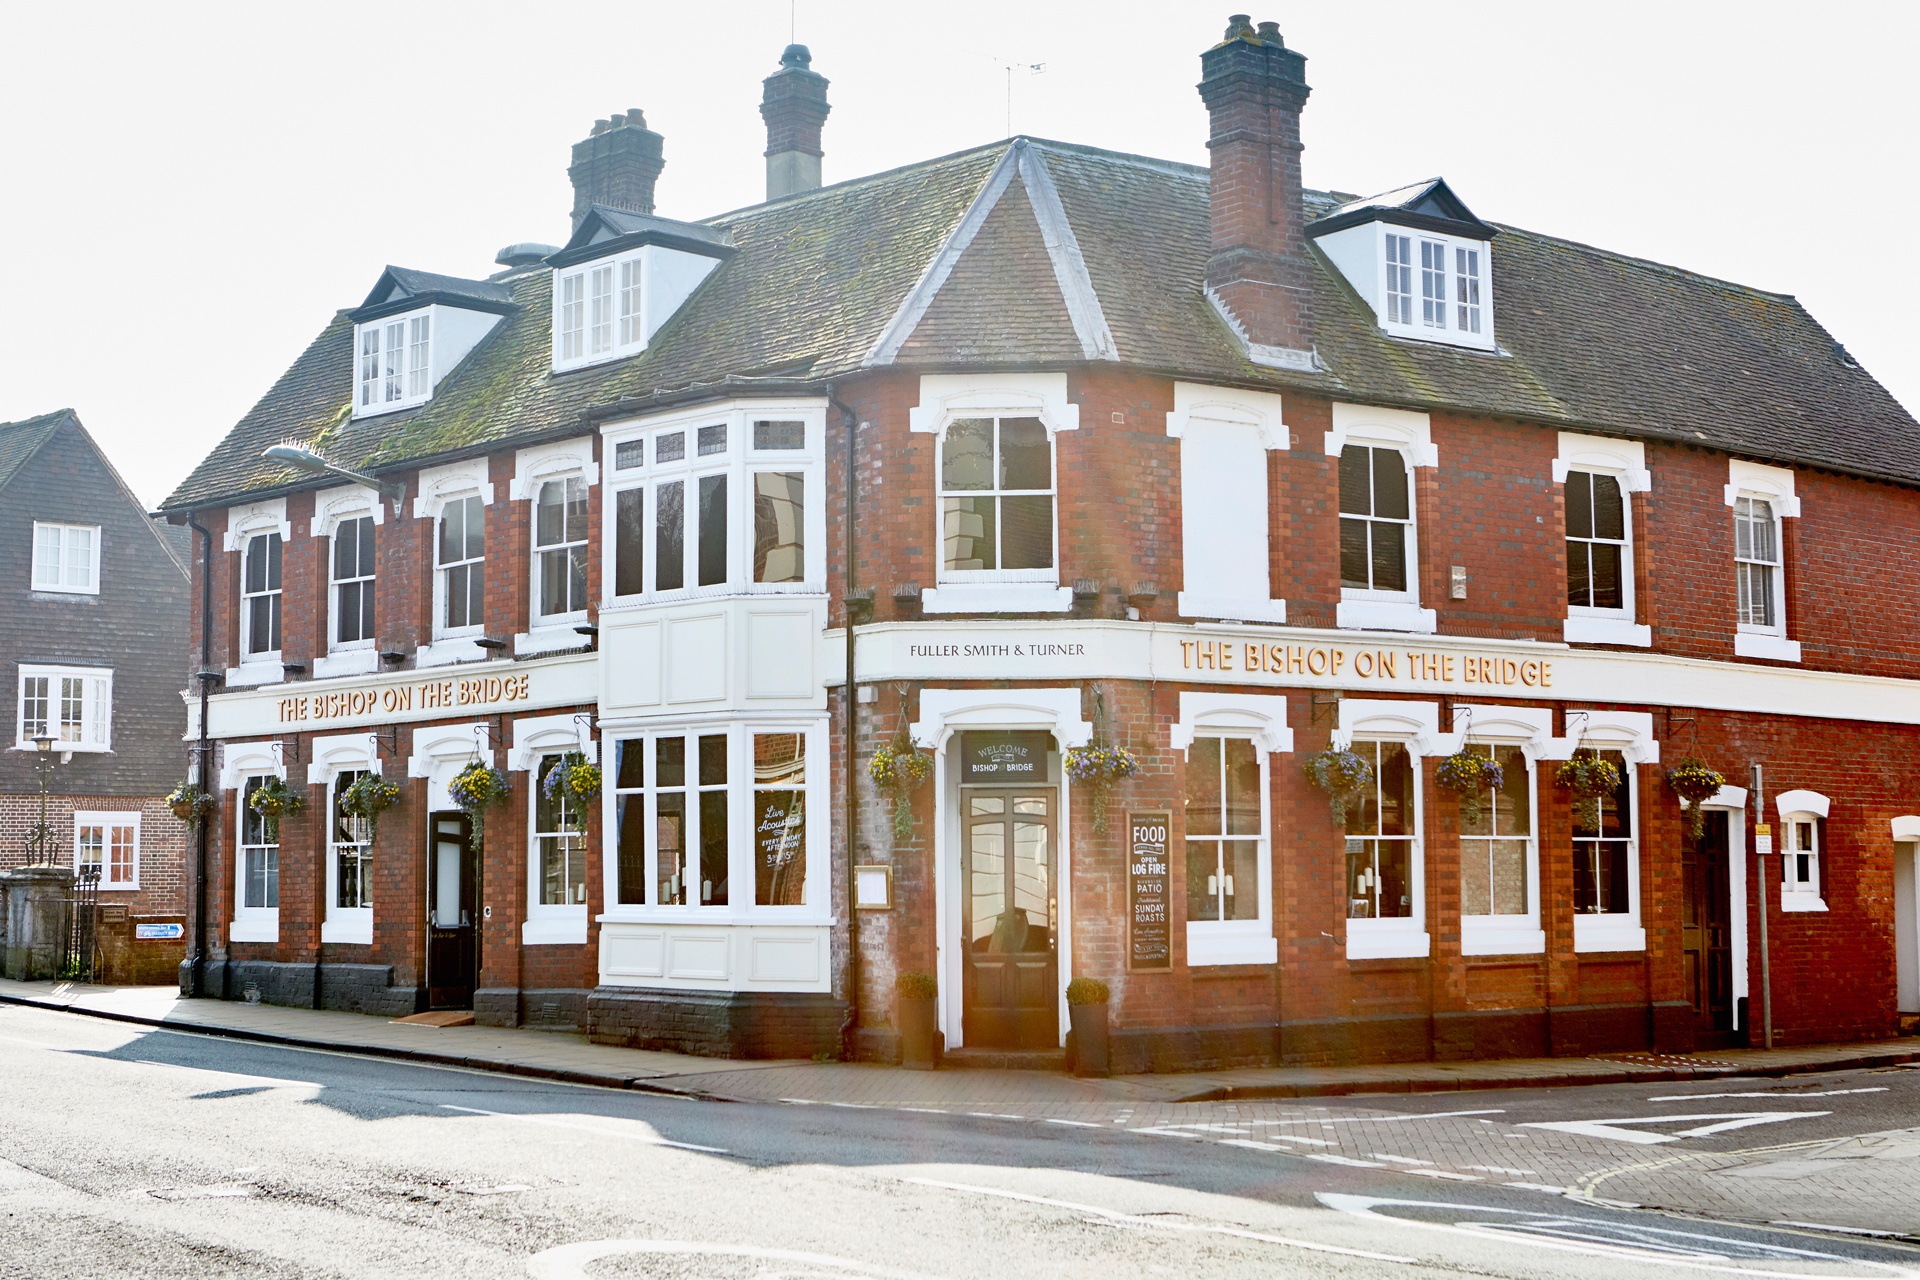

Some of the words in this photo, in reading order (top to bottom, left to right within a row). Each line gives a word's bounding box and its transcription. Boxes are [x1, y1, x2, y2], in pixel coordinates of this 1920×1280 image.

[910, 645, 959, 656] FULLER
[964, 645, 1009, 656] SMITH
[1014, 644, 1024, 656] &
[1029, 644, 1084, 656] TURNER
[1180, 640, 1232, 670] THE
[1245, 642, 1344, 676] BISHOP
[1354, 651, 1396, 678] ON
[1407, 652, 1454, 682] THE
[1464, 655, 1552, 688] BRIDGE
[277, 698, 307, 722] THE
[313, 690, 376, 718] BISHOP
[382, 686, 411, 712] ON
[418, 682, 452, 708] THE
[458, 674, 529, 705] BRIDGE
[978, 744, 1028, 757] WELCOME
[1006, 764, 1034, 772] BRIDGE
[765, 805, 784, 818] Live
[1133, 826, 1166, 842] FOOD
[1132, 864, 1146, 875] LOG
[1148, 864, 1166, 875] FIRE
[1137, 884, 1162, 893] PATIO
[1135, 904, 1165, 913] SUNDAY
[1135, 913, 1165, 922] ROASTS
